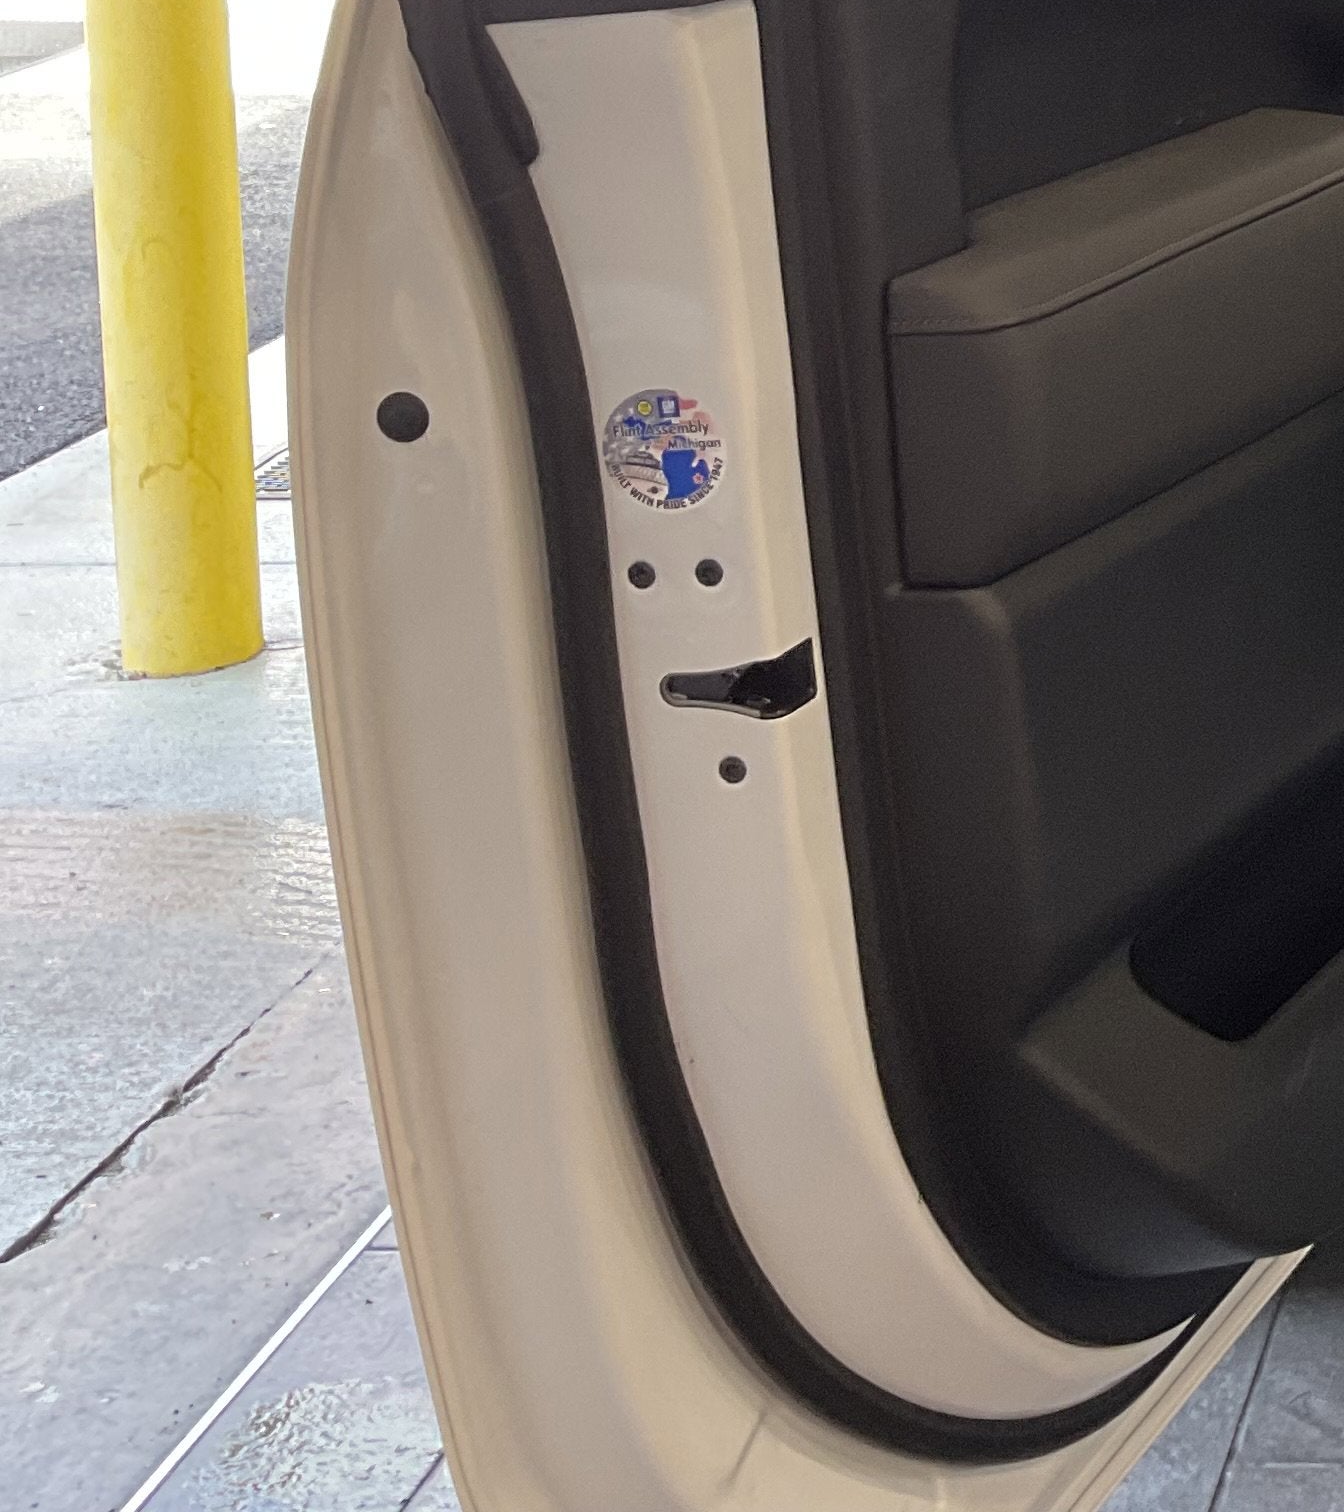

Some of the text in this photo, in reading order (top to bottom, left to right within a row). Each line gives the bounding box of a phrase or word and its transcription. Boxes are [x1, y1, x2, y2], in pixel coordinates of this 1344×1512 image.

[613, 421, 709, 437] Flint Assembly
[668, 439, 721, 451] Michigan
[611, 464, 631, 489] BUILT
[630, 487, 654, 507] WITH
[656, 497, 687, 509] PRIDE
[688, 482, 714, 505] SINCE
